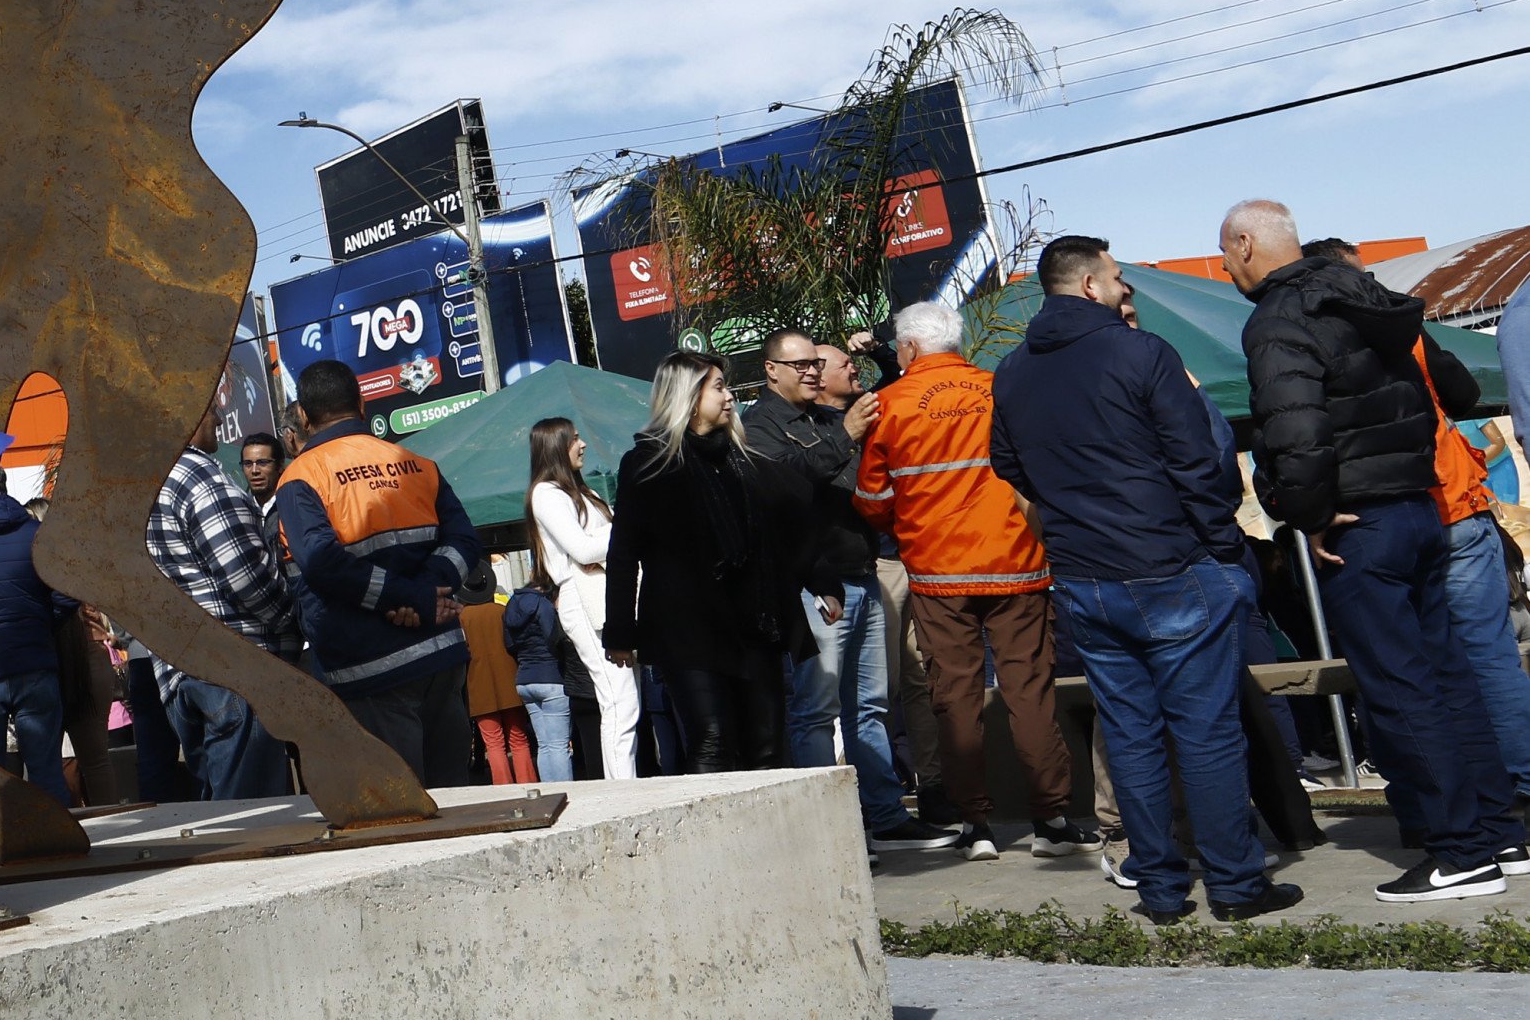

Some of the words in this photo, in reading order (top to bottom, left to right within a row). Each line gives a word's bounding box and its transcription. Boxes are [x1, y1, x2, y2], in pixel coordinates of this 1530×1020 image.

[344, 219, 397, 255] ANUNCIE
[401, 204, 432, 230] 3472
[891, 227, 944, 246] CORPORATIVO
[625, 300, 639, 309] FIXA
[351, 298, 424, 358] 700
[384, 318, 409, 333] MEGA
[918, 380, 957, 411] DEFESA
[959, 380, 993, 402] CIVIL
[402, 410, 421, 428] (51)
[335, 464, 384, 485] DEFESA
[386, 460, 423, 477] CIVIL
